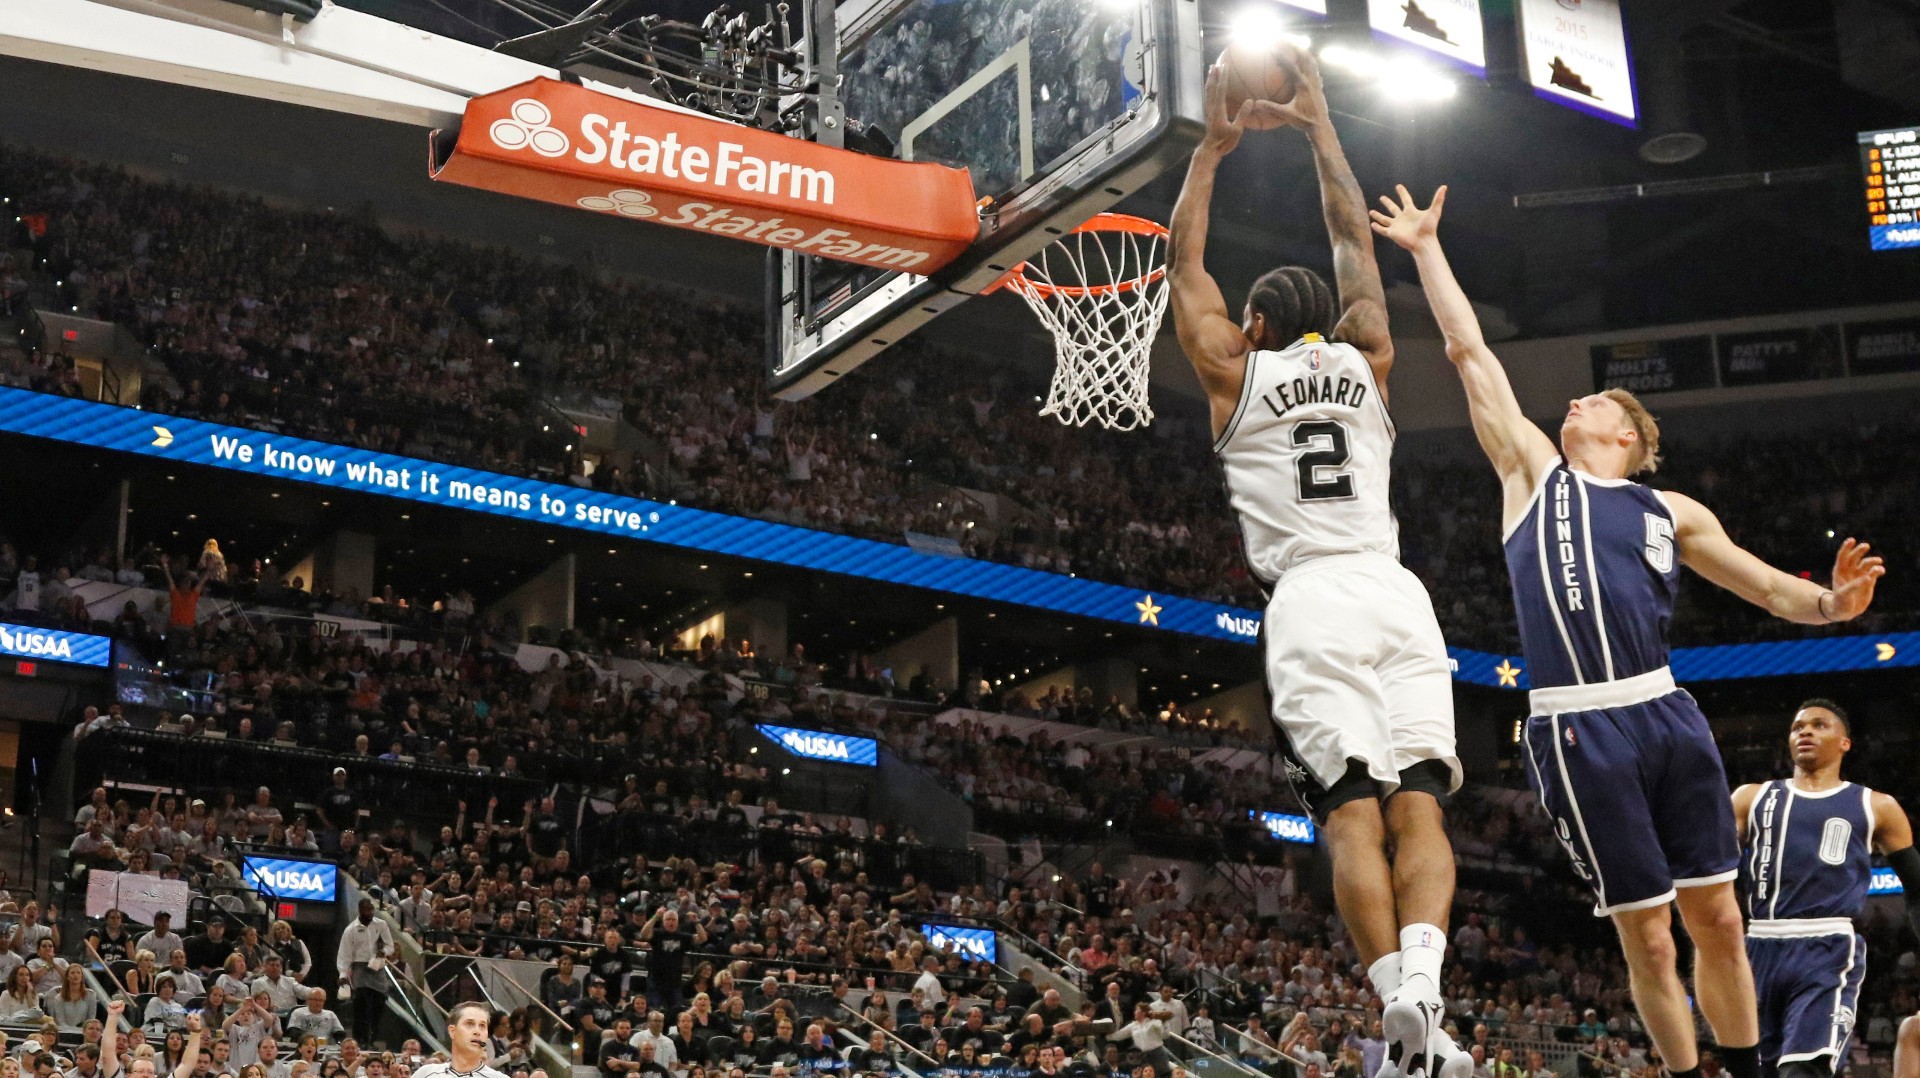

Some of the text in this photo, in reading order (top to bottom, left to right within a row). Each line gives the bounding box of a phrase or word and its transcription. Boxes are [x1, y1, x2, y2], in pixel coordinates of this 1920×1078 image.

[1555, 16, 1589, 40] 2015
[1529, 30, 1617, 69] LARGE INDOOR
[1874, 131, 1916, 145] SPURS
[575, 113, 835, 204] State Farm
[659, 202, 929, 267] State Farm
[1606, 357, 1668, 376] HOLT'S
[1732, 341, 1797, 356] PATTY'S
[1262, 375, 1367, 418] LEONARD
[1604, 373, 1673, 389] HEROES
[210, 434, 253, 463] We
[263, 443, 335, 477] know
[346, 462, 410, 490] what
[420, 470, 439, 495] it
[449, 480, 531, 510] means
[540, 493, 566, 516] to
[1289, 418, 1358, 503] 2
[1555, 470, 1584, 612] THUNDER
[1644, 512, 1675, 574] 5
[15, 632, 71, 657] USAA
[314, 621, 339, 638] 107
[805, 736, 849, 759] USAA
[1757, 788, 1781, 900] THUNDER
[1819, 816, 1853, 866] 0
[276, 870, 324, 892] USAA
